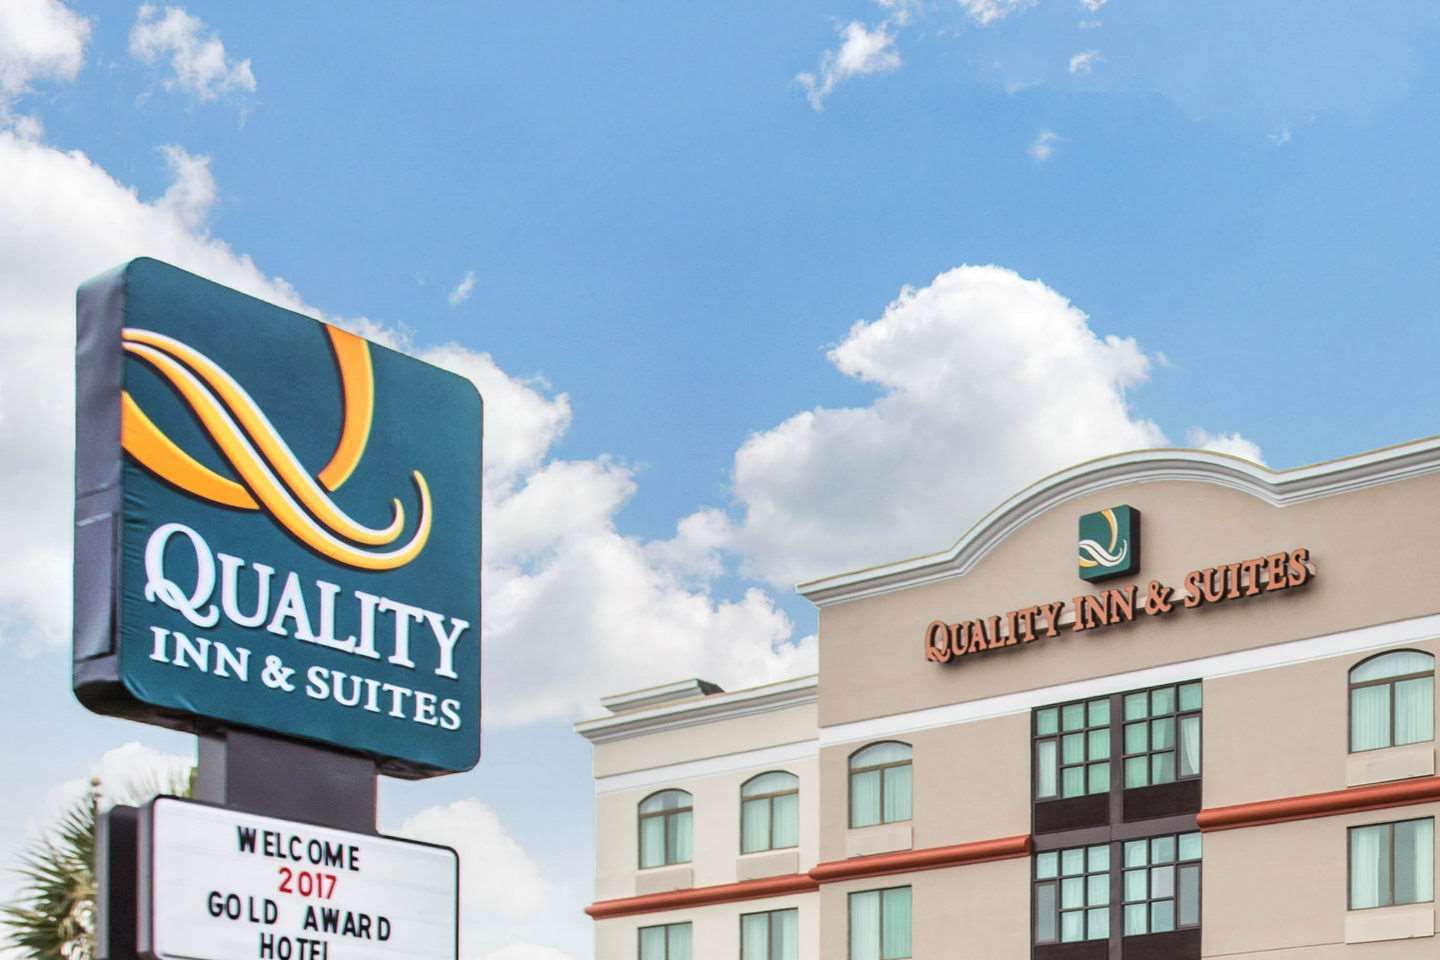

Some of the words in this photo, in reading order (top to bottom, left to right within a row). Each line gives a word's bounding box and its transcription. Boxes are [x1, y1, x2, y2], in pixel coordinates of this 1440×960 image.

[144, 522, 470, 680] QUALITY
[924, 601, 1064, 664] QUALITY
[1072, 584, 1138, 632] INN
[1144, 580, 1174, 615] &
[1184, 547, 1311, 608] SUITES
[149, 626, 251, 682] INN
[261, 655, 296, 692] &
[305, 666, 462, 731] SUITES
[237, 825, 360, 872] WELCOME
[278, 867, 338, 900] 2017
[208, 891, 279, 925] GOLD
[303, 906, 391, 942] AWARD
